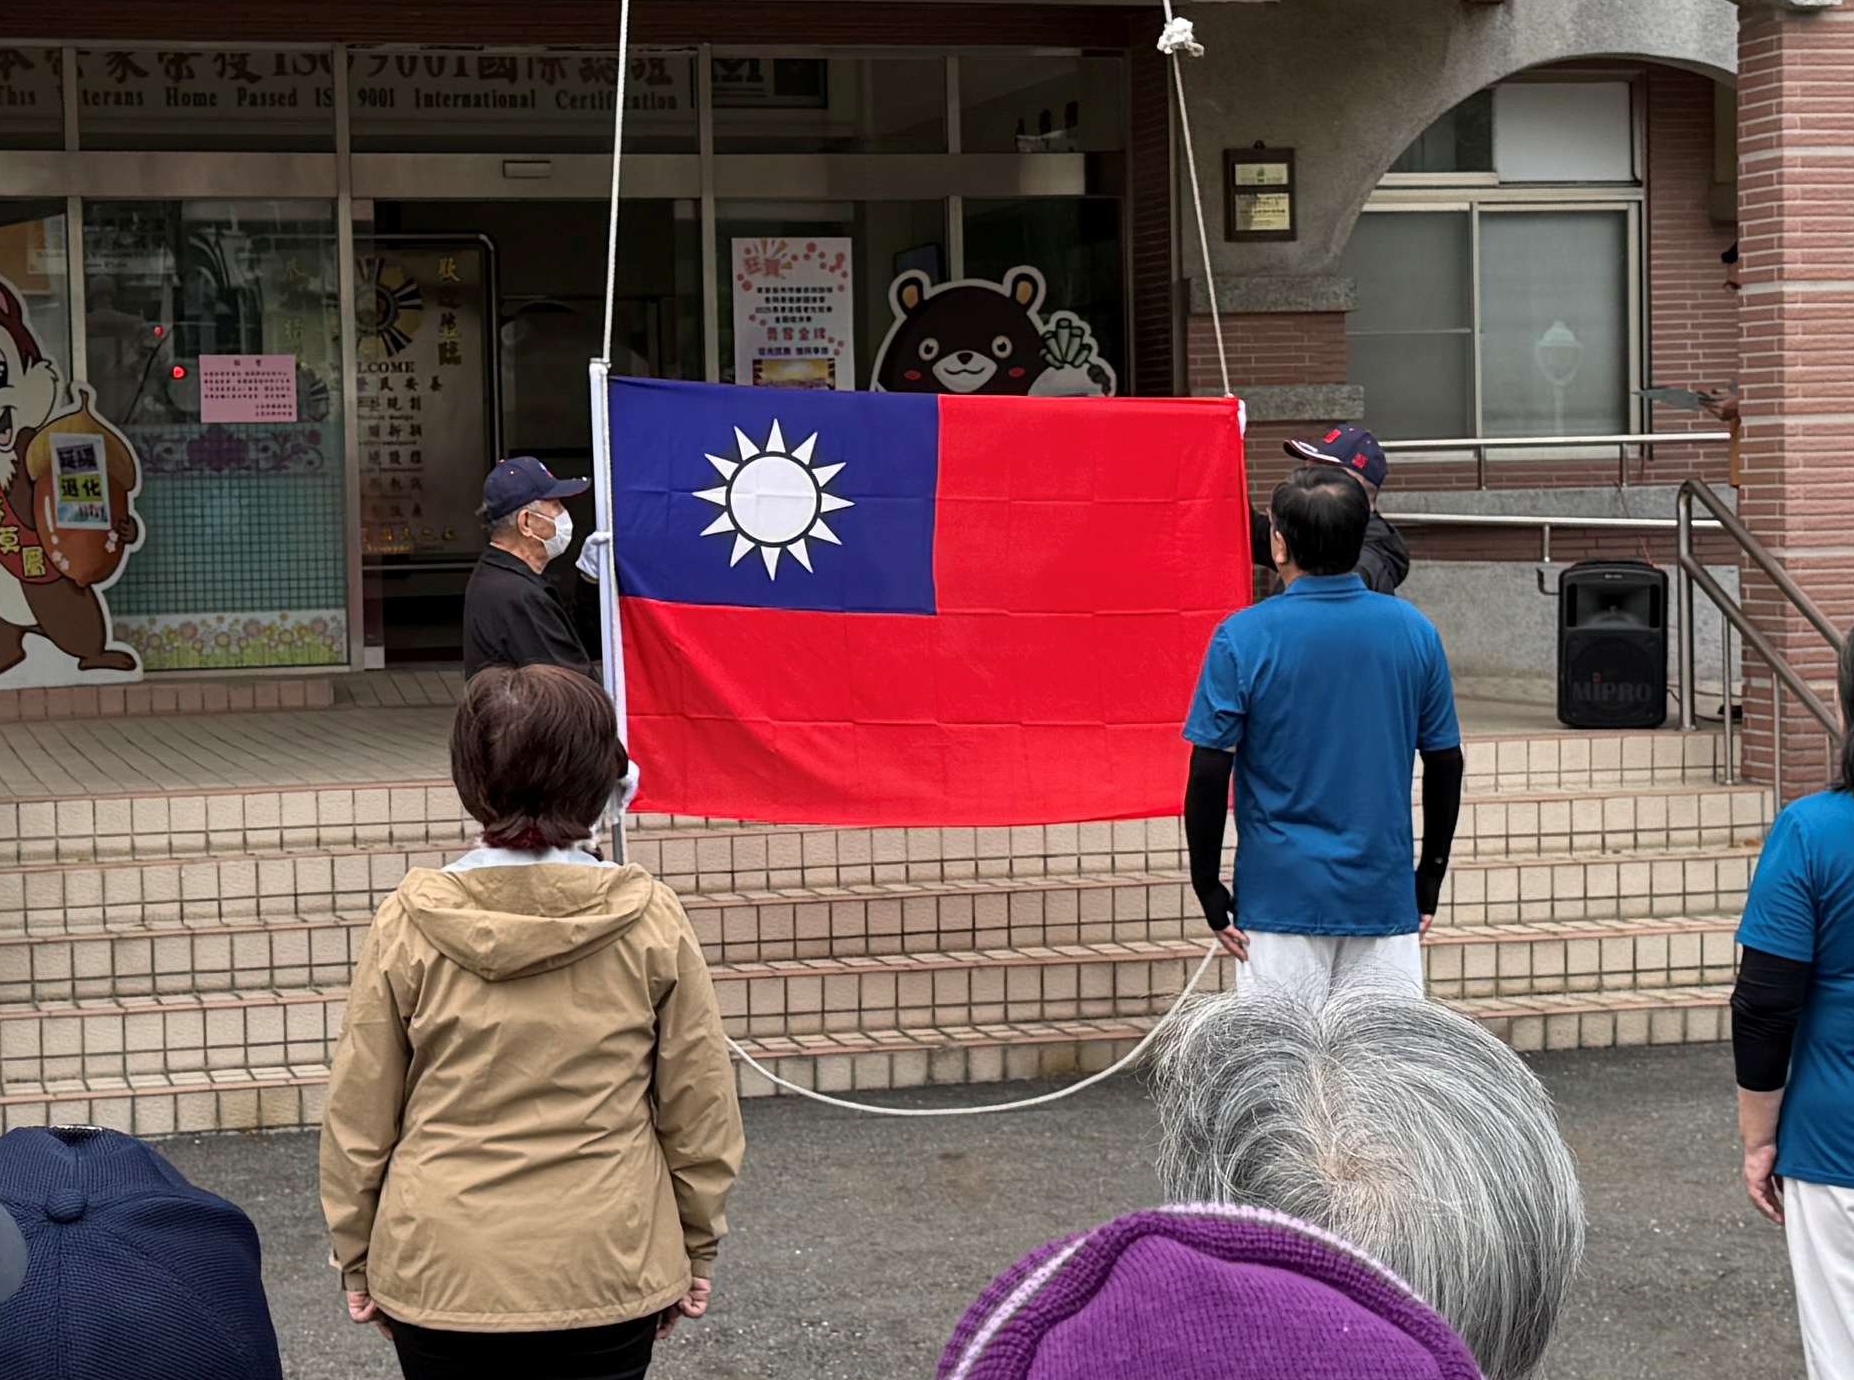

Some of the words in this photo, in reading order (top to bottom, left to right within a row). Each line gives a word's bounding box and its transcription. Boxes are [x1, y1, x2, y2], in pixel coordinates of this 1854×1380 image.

[165, 86, 219, 108] Home
[237, 86, 299, 108] Passed
[415, 87, 536, 109] International
